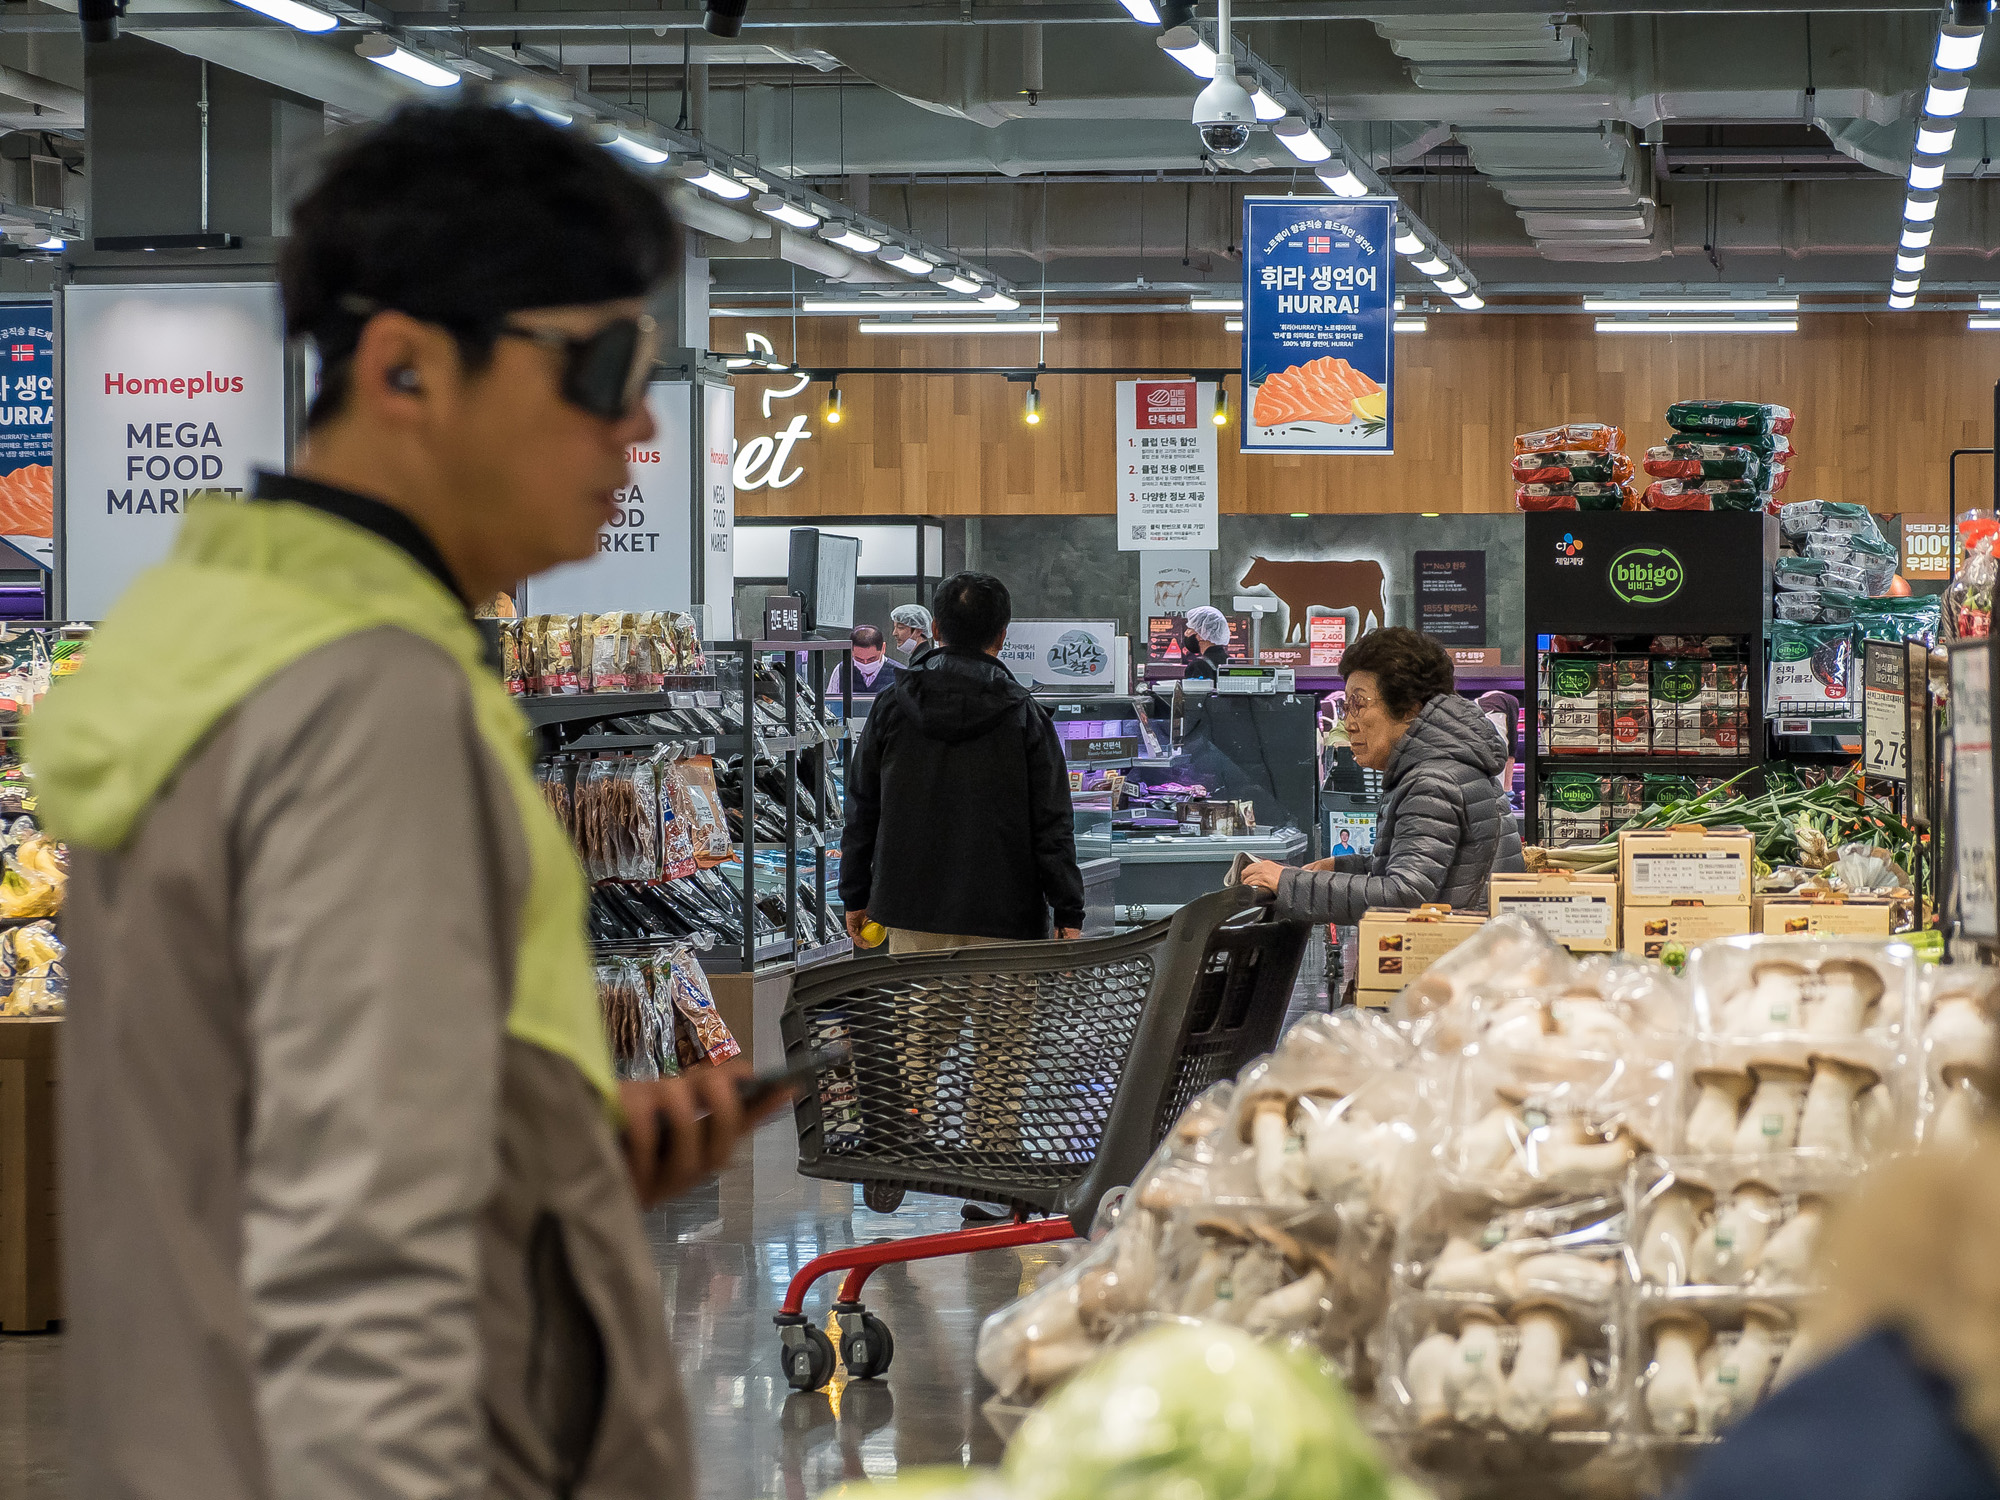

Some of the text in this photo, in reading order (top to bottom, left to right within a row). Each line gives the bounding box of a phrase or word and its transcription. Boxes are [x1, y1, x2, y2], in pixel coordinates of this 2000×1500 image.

[1263, 219, 1376, 256] 노르웨이 항공직송 콜드체인 생연어
[1260, 265, 1377, 292] 휘라 생연어
[1278, 294, 1360, 314] HURRA!
[0, 326, 53, 343] 공직송 콜드체
[104, 371, 244, 400] Homeplus
[1148, 414, 1186, 425] 단독혜택
[127, 421, 223, 449] MEGA
[1128, 437, 1197, 447] 1. 클럽 단독 할인
[127, 454, 223, 481] FOOD
[1128, 463, 1205, 475] 2. 클럽 전용 이벤트
[712, 485, 726, 504] MEGA
[1129, 491, 1205, 502] 3. 다양한 정보 제공
[712, 509, 726, 528] FOOD
[1905, 524, 1936, 533] 부드럽고
[710, 533, 728, 552] MARKET
[1555, 542, 1567, 551] CJ
[1905, 534, 1961, 555] 100%
[1555, 557, 1584, 566] 제일제당
[1617, 563, 1678, 587] bibigo
[1627, 581, 1654, 591] 비비고
[1423, 604, 1442, 612] 1855
[1017, 651, 1035, 660] 돼지!
[1050, 642, 1102, 665] 지리산
[1776, 665, 1795, 674] 직화
[1875, 662, 1899, 674] 농식품부
[1776, 675, 1813, 685] 참기름김
[1558, 714, 1591, 724] 참기름김
[1102, 740, 1121, 750] 간편식
[1559, 828, 1593, 839] 참기름김
